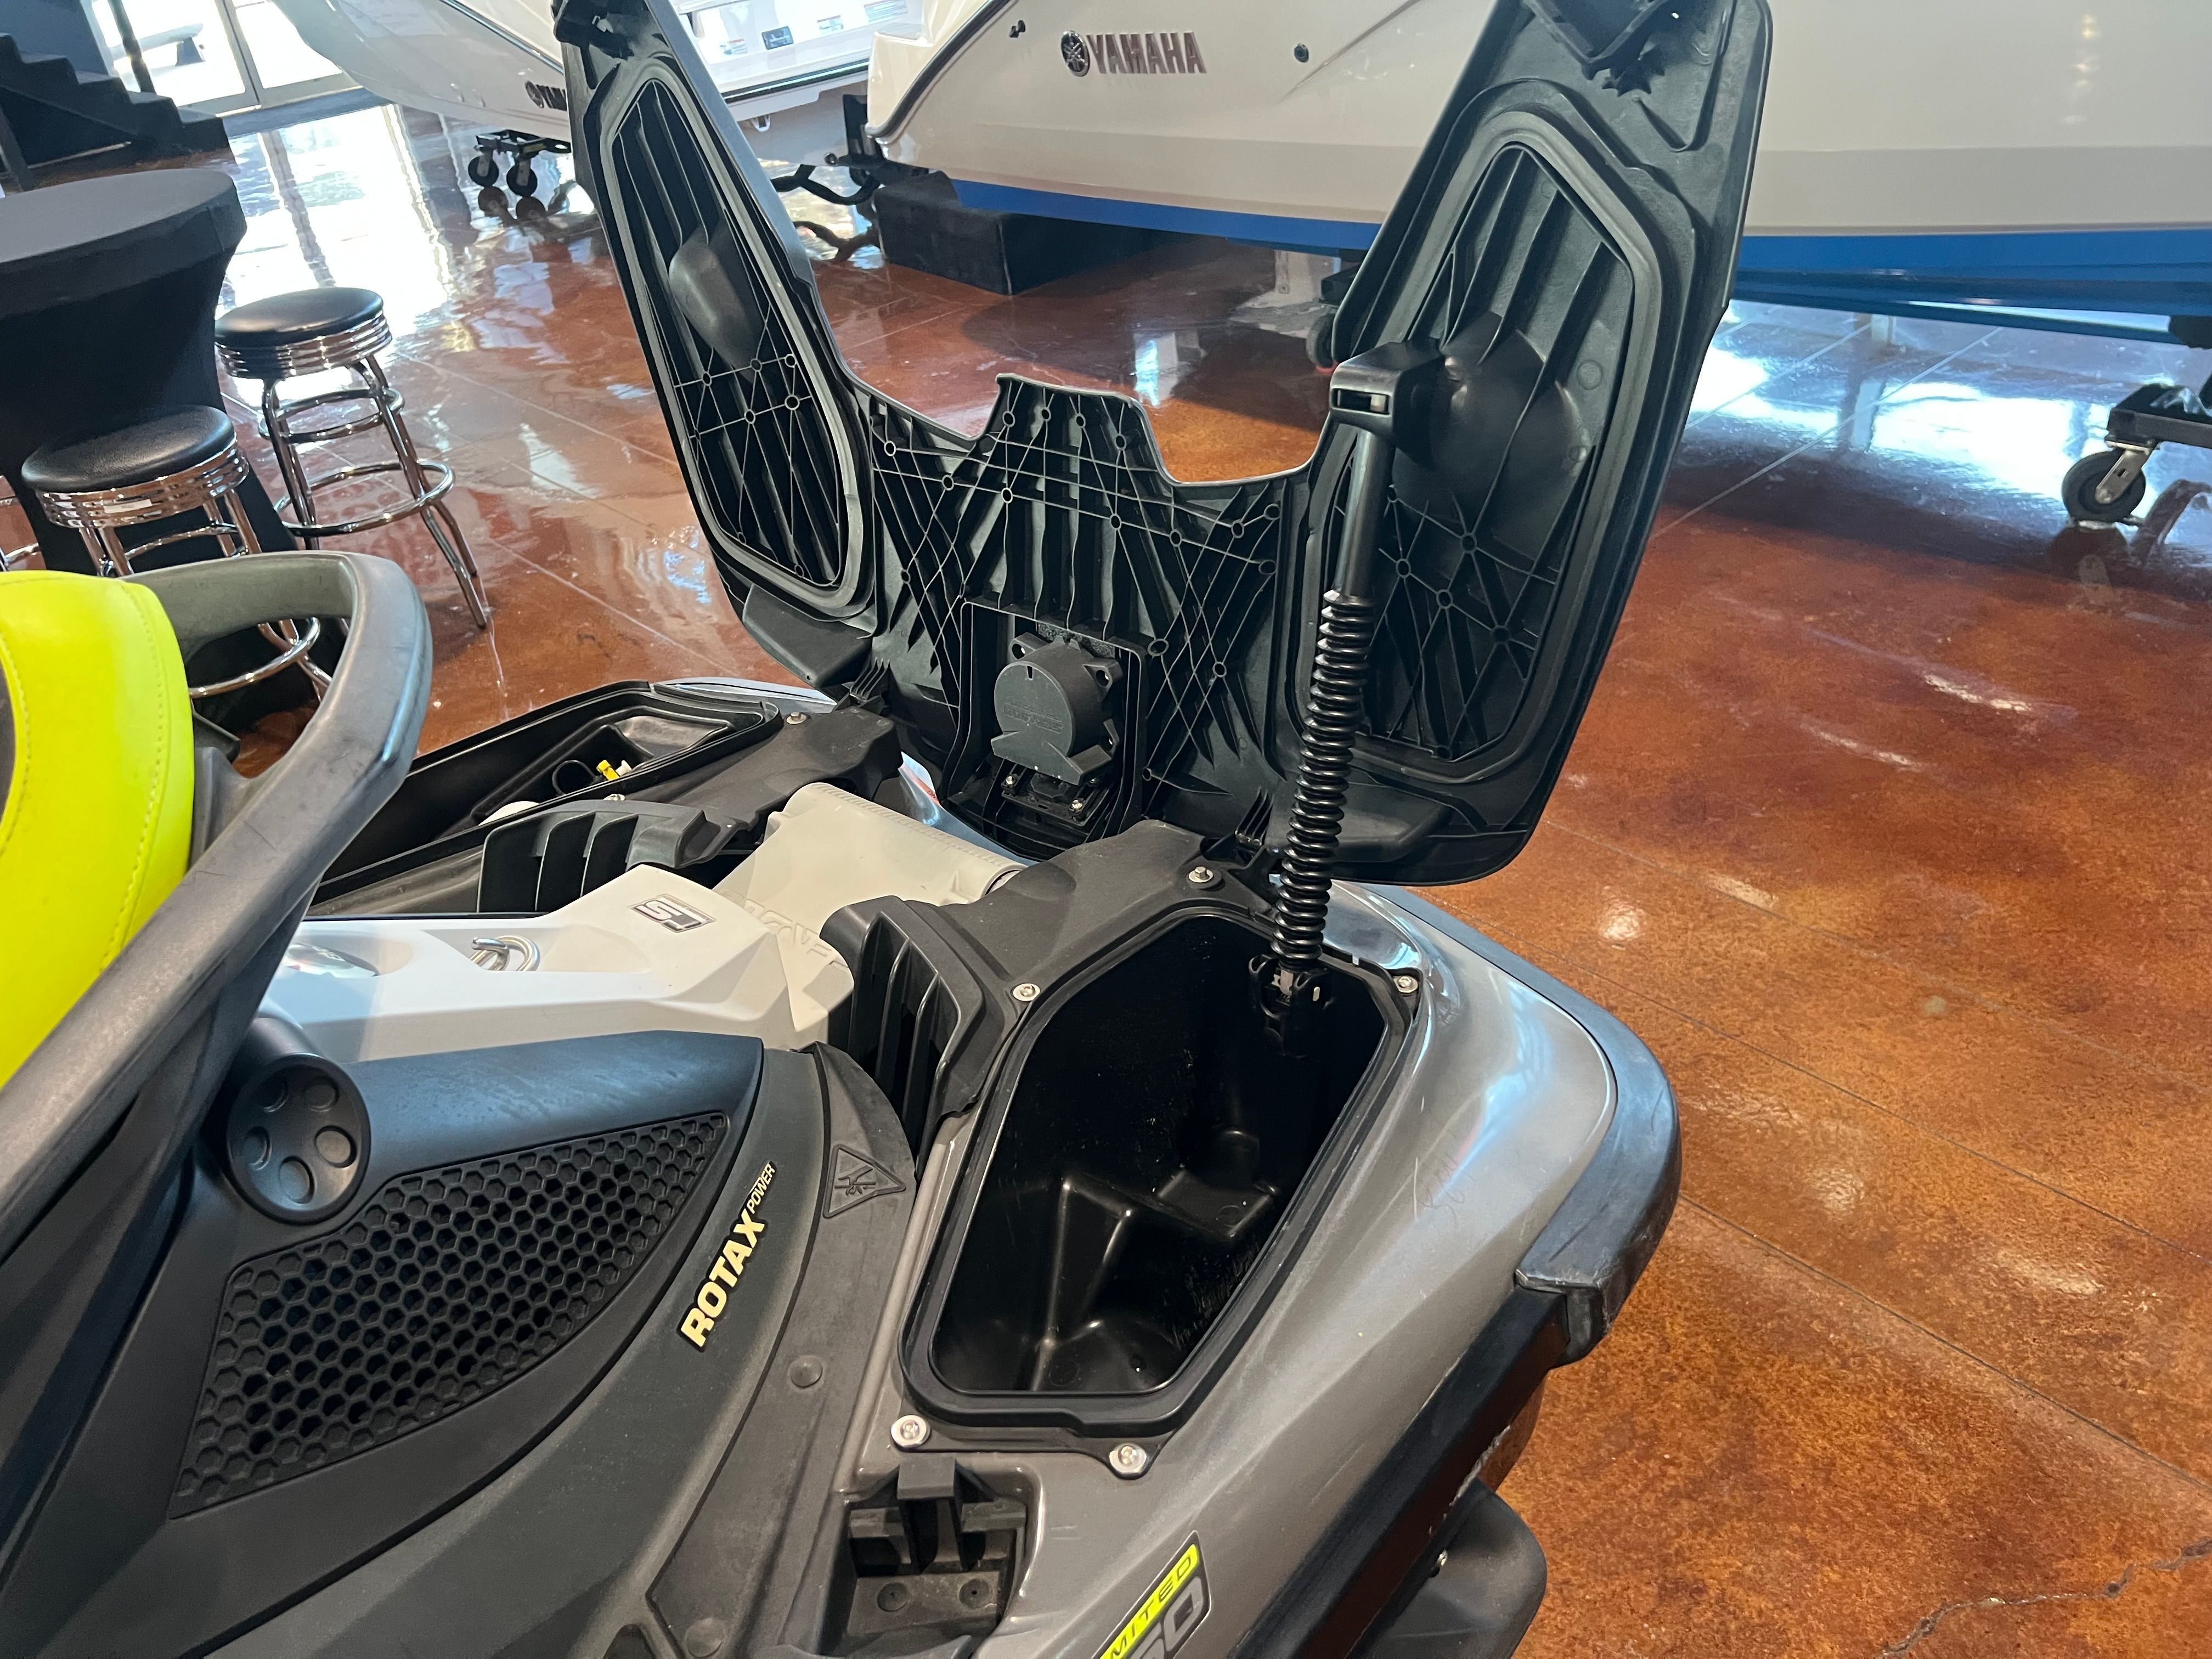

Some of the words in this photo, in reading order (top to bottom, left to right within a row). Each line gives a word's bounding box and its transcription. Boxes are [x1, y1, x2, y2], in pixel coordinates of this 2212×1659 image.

[1086, 32, 1206, 74] YAMAHA
[681, 1209, 765, 1346] ROTAX
[747, 1163, 775, 1214] POWER
